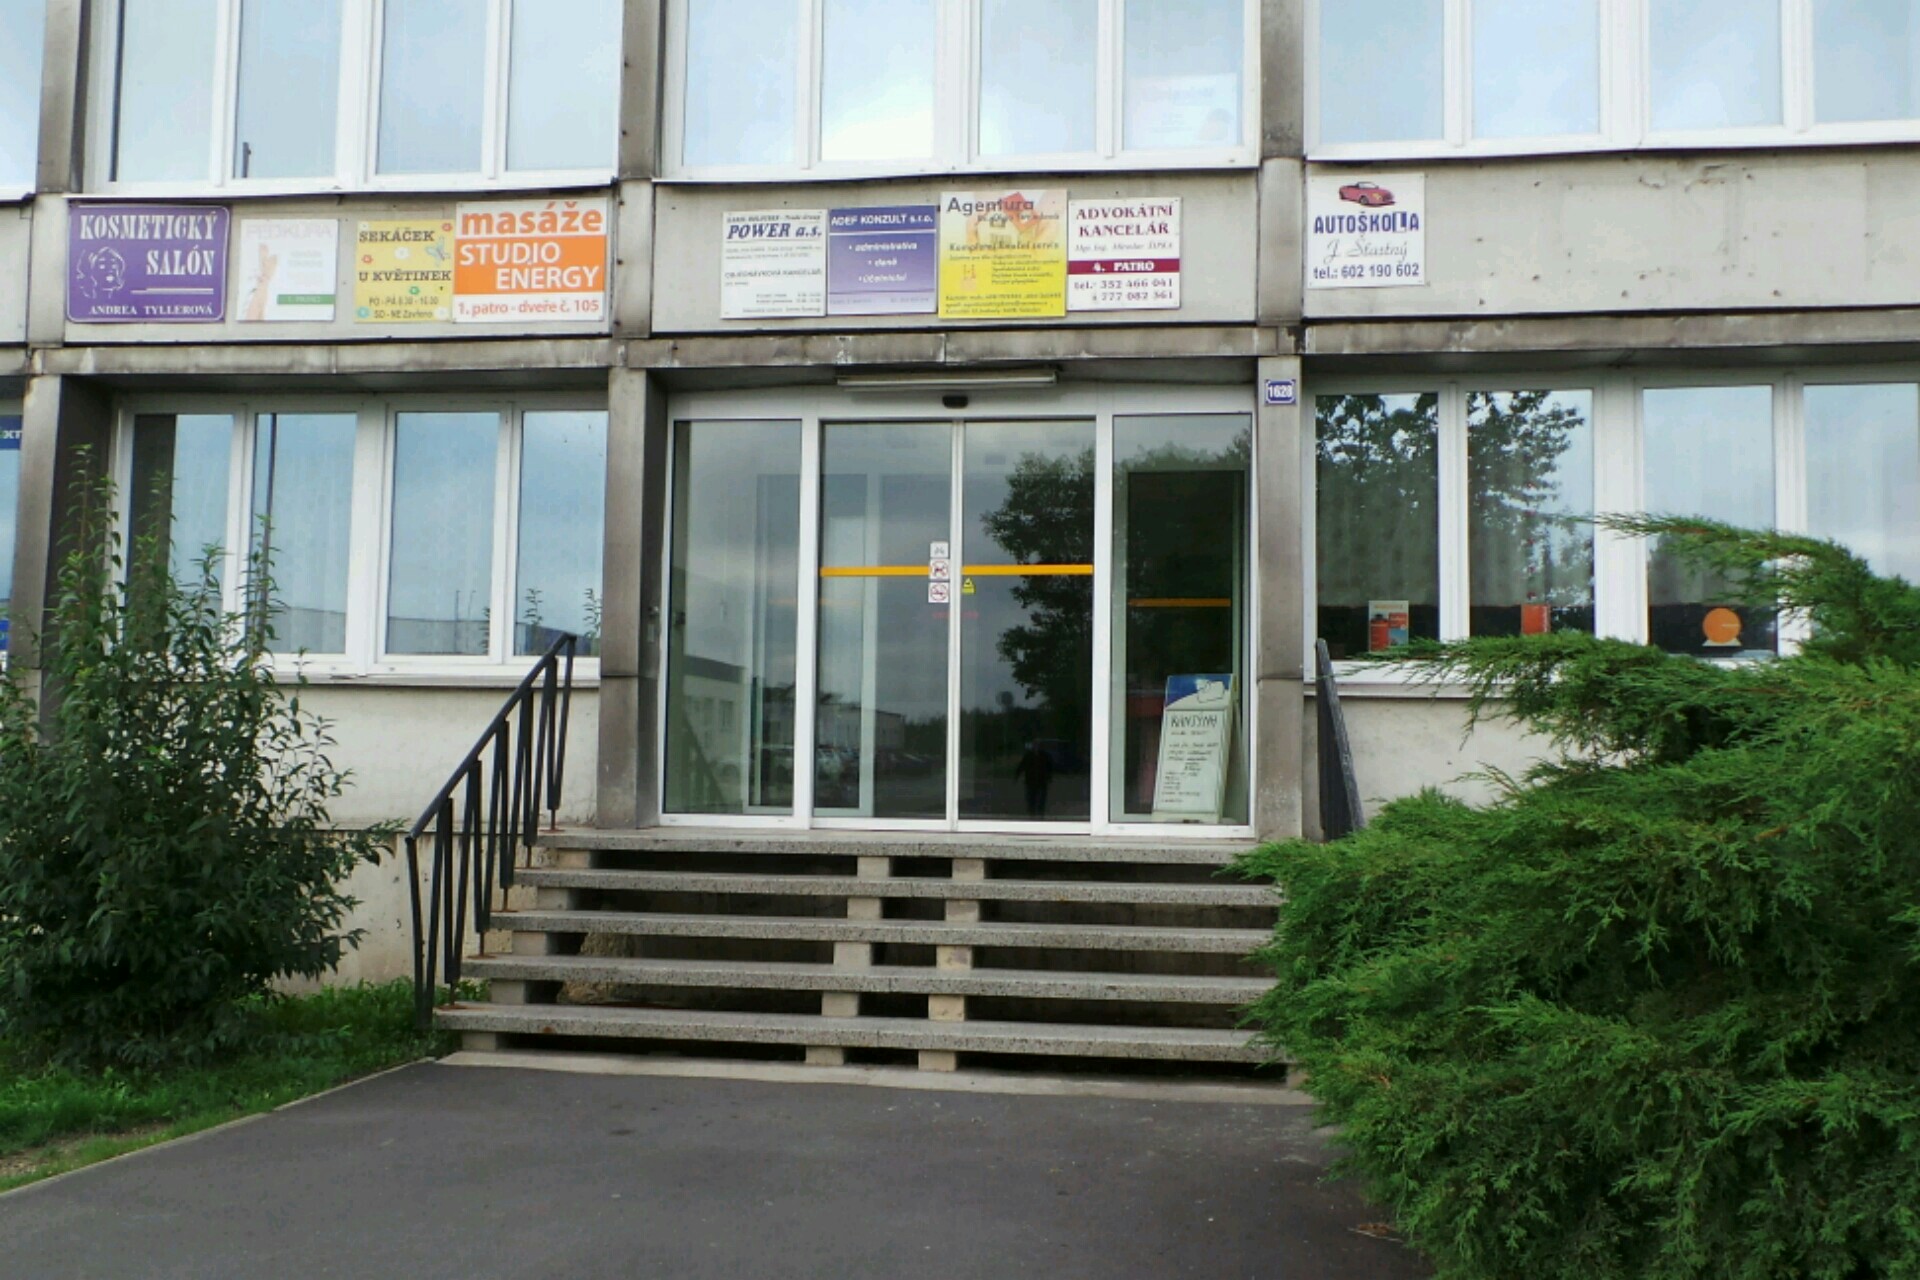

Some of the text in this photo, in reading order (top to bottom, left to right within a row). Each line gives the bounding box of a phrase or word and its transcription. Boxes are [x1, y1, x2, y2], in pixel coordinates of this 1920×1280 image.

[946, 196, 1034, 216] Agentura
[1076, 202, 1173, 220] ADVOKÁTNÍ
[80, 211, 218, 240] KOSMETICKÝ
[461, 201, 603, 235] masáže
[860, 213, 907, 225] KONZULT
[909, 214, 934, 224] s.r.o.
[1313, 210, 1420, 234] AUTOŠKOLA
[359, 227, 435, 242] SEKÁČEK
[726, 222, 822, 240] POWER a.s.
[1078, 221, 1169, 238] KANCELÁŘ
[459, 241, 561, 266] STUDIO
[854, 241, 918, 252] administrativa
[146, 244, 215, 275] SALÓN
[874, 257, 898, 267] daně
[1113, 261, 1155, 272] PATRO
[359, 268, 452, 282] U KVĚTINEK
[496, 266, 600, 290] ENERGY
[1313, 262, 1420, 280] tel.: 602 190 602
[89, 305, 137, 315] ANDREA
[458, 302, 469, 315] 1.
[471, 302, 508, 317] patro
[518, 300, 557, 313] dveře
[559, 299, 570, 313] č.
[574, 299, 600, 313] 105
